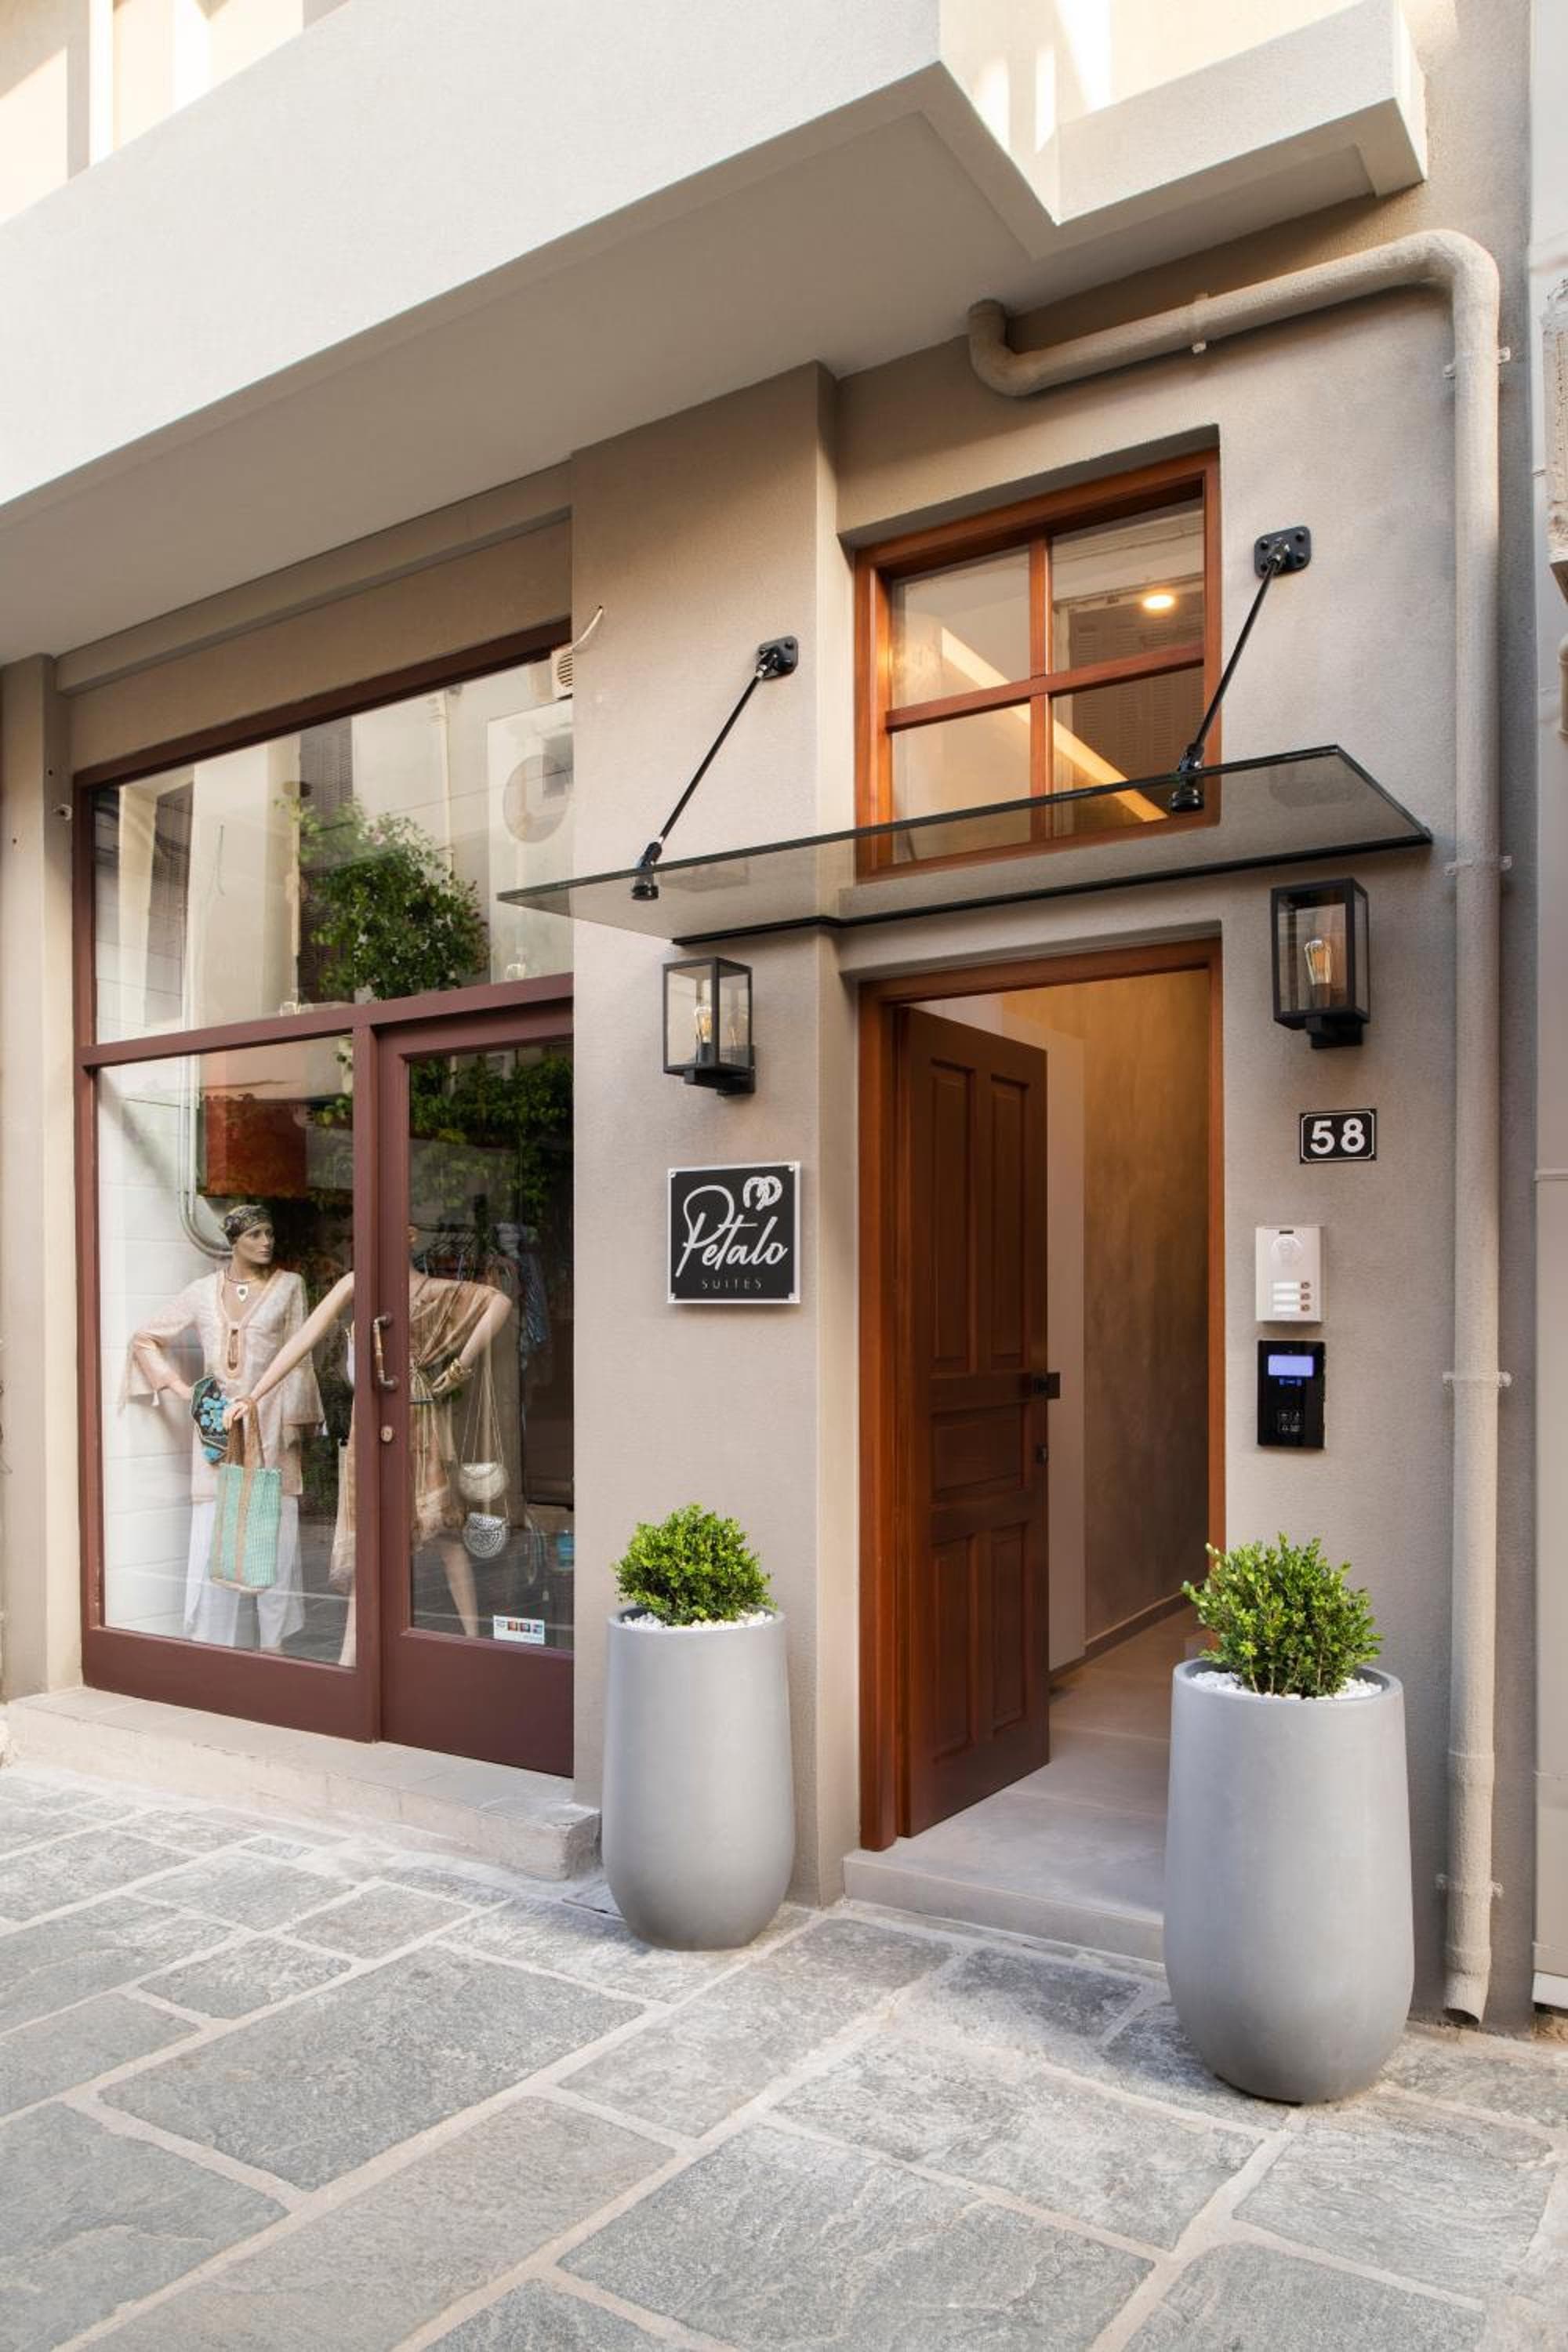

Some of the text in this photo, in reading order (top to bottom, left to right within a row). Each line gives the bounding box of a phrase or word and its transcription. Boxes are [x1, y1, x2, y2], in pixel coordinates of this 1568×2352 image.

[1310, 1118, 1366, 1155] 58
[674, 1184, 789, 1279] Petalo
[701, 1279, 763, 1290] SUITES
